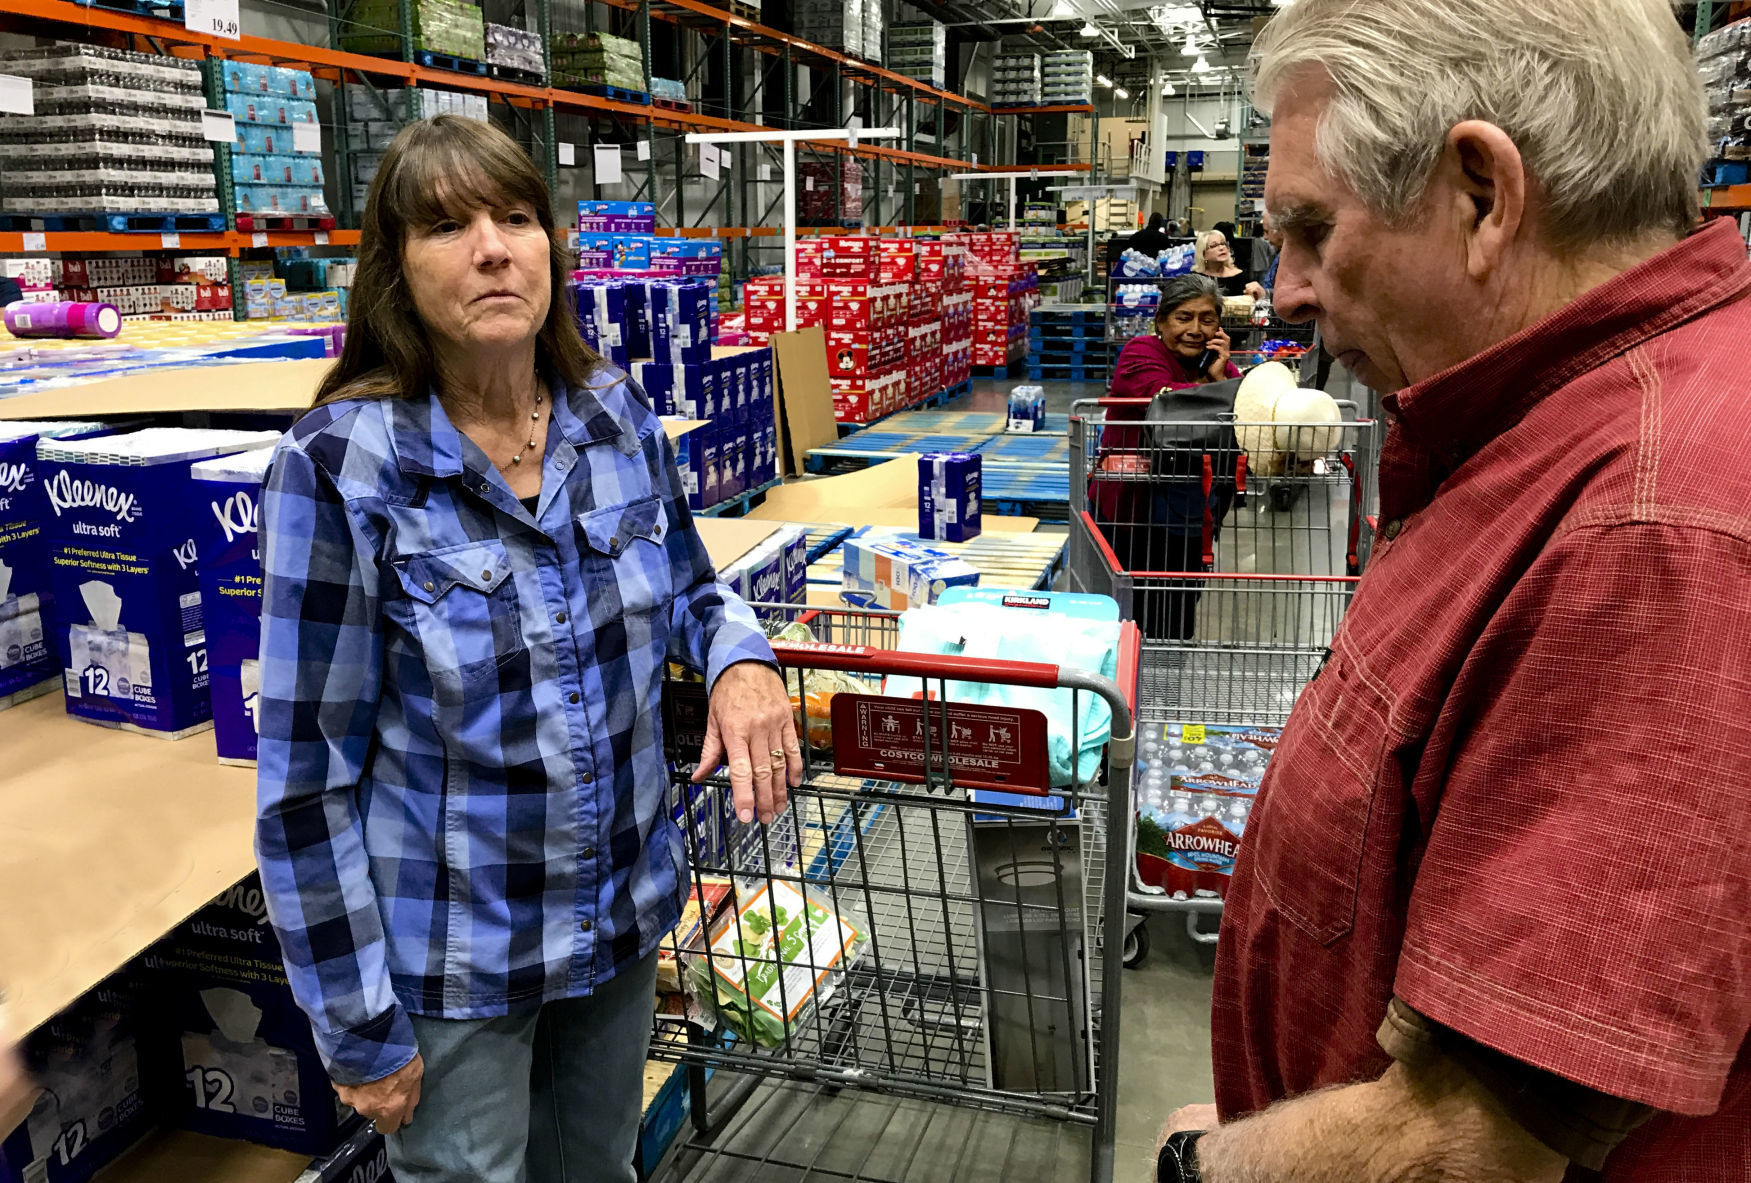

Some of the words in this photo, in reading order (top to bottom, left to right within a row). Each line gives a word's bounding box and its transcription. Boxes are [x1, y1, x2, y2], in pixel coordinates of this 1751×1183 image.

[212, 18, 238, 35] 19.49
[44, 469, 134, 522] Kleenex
[72, 521, 97, 535] ultra
[12, 533, 17, 541] 3
[63, 547, 71, 555] #1
[72, 548, 99, 558] Preferred
[100, 550, 115, 560] Ultra
[116, 552, 137, 562] Tissue
[54, 557, 79, 567] Superior
[80, 560, 106, 570] Softness
[107, 563, 120, 571] with
[219, 586, 256, 597] Superior
[1004, 596, 1049, 605] KIRKLAND
[187, 650, 209, 674] 12
[84, 667, 109, 696] 12
[134, 686, 152, 696] CUBE
[134, 694, 156, 704] BOXES
[880, 750, 925, 761] COSTCO
[1166, 832, 1240, 858] ARROWHEA
[192, 921, 228, 939] ultra
[187, 948, 229, 963] Preferred
[230, 955, 252, 967] Ultra
[254, 958, 284, 972] Tissue
[199, 961, 239, 977] Softness
[240, 970, 260, 980] with
[261, 974, 268, 982] 3
[186, 1068, 236, 1114] 12
[274, 1105, 300, 1116] CUBE
[275, 1114, 305, 1126] BOXES
[54, 1121, 88, 1166] 12
